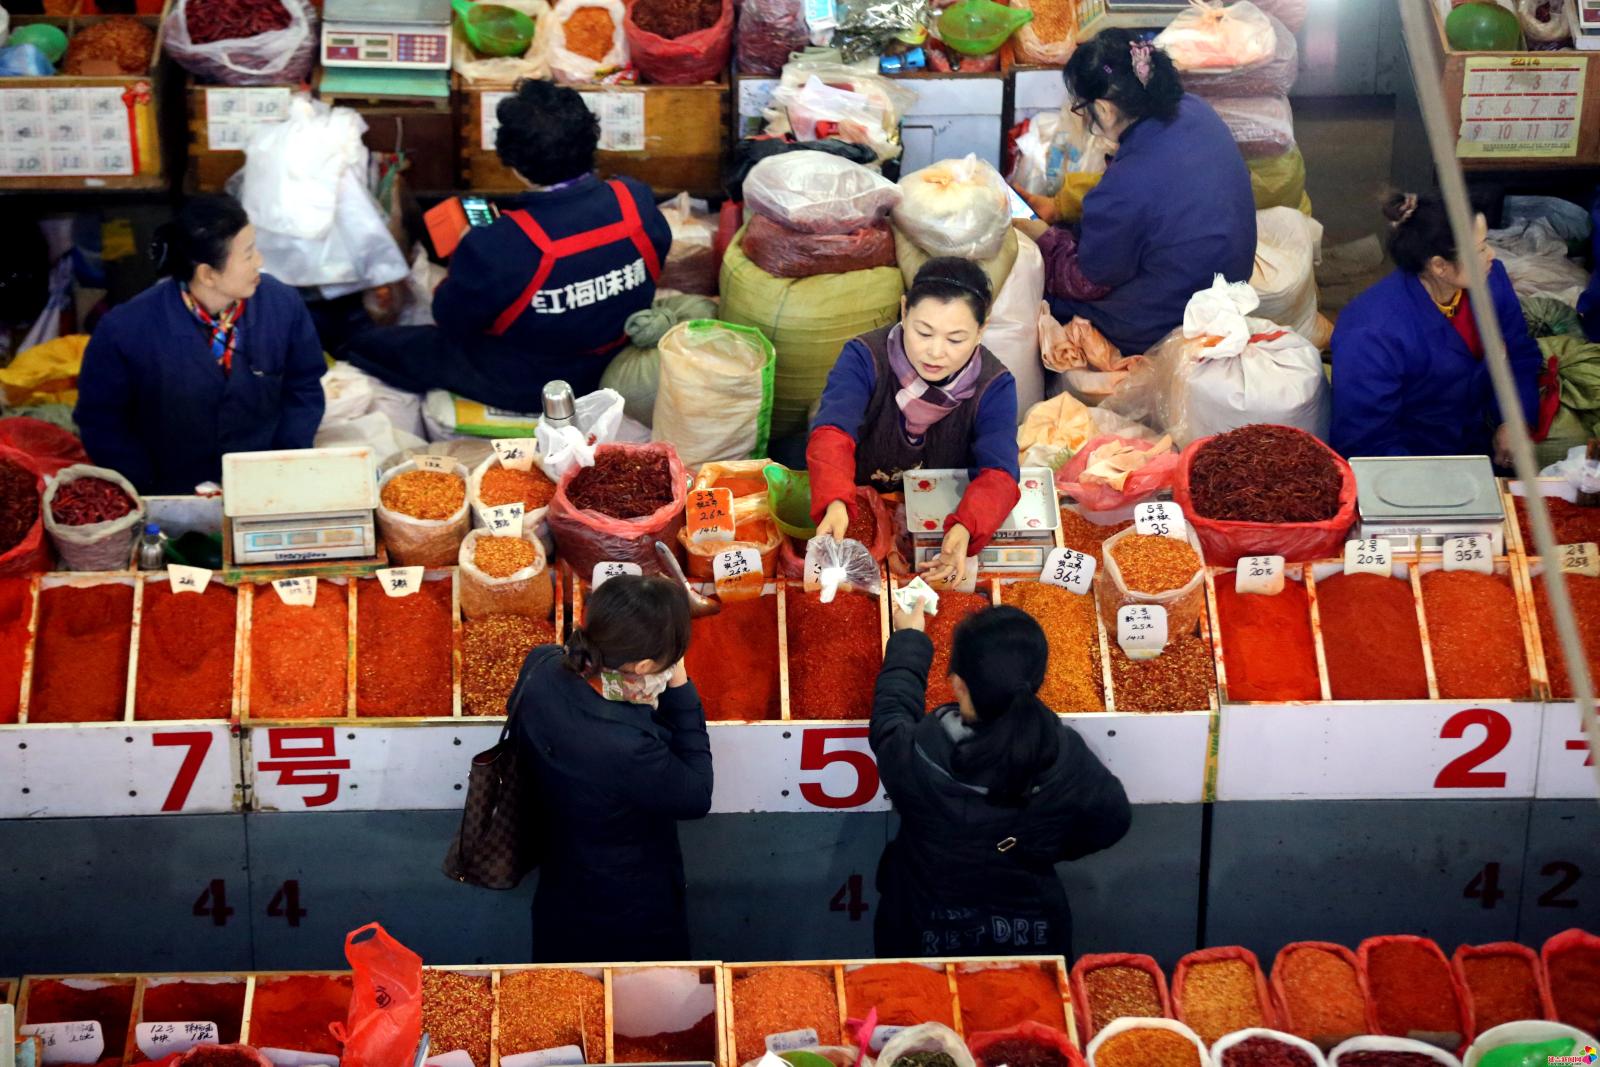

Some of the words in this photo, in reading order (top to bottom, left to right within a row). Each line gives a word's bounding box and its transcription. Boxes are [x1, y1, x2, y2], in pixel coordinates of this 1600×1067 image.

[1504, 74, 1515, 91] 2
[1560, 74, 1571, 91] 4
[1474, 99, 1485, 116] 5
[1503, 99, 1513, 115] 6
[1530, 99, 1541, 115] 7
[1557, 99, 1568, 115] 8
[1498, 124, 1513, 140] 10
[1526, 124, 1541, 140] 11
[1553, 123, 1569, 139] 12
[531, 257, 646, 314] 红梅味精
[696, 490, 714, 501] 5号
[1146, 503, 1165, 516] 5号
[1150, 523, 1170, 537] 35
[1357, 539, 1378, 553] 2号
[1455, 538, 1479, 550] 2号
[723, 550, 744, 563] 5号
[1063, 549, 1086, 566] 5号
[1356, 554, 1387, 566] 20元
[1454, 549, 1486, 562] 35元
[1053, 567, 1082, 585] 36元
[1248, 566, 1275, 578] 20元
[1130, 607, 1148, 617] 5号
[799, 727, 880, 809] 5
[1464, 862, 1504, 909] 4
[1538, 861, 1582, 908] 2
[193, 879, 234, 926] 4
[267, 880, 307, 927] 4
[830, 874, 869, 921] 4
